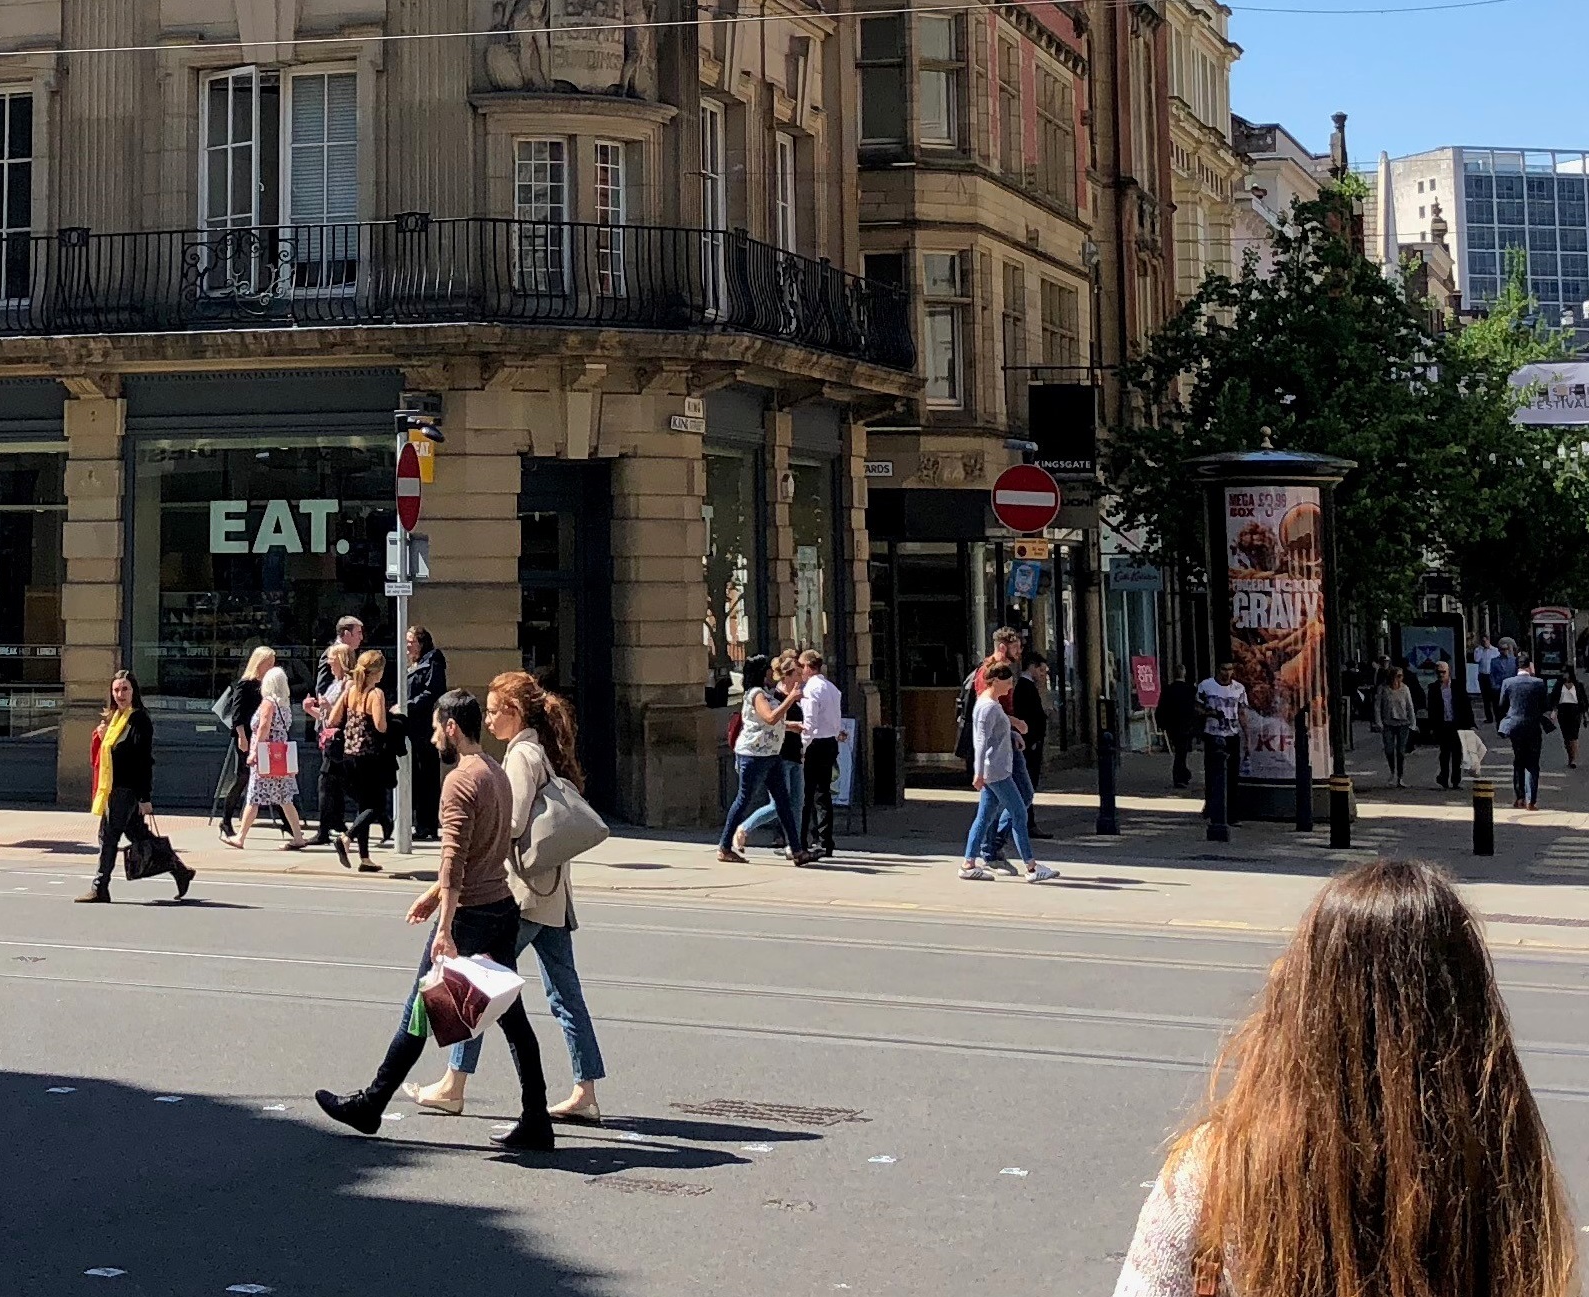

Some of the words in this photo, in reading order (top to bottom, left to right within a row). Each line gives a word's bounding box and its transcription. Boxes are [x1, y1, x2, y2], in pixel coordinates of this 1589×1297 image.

[1034, 460, 1091, 469] KINGSGATE
[1229, 494, 1255, 507] MEGA
[1230, 508, 1256, 518] BOX
[209, 499, 350, 555] EAT.
[1233, 591, 1319, 629] GRAVY
[1255, 734, 1294, 752] KF
